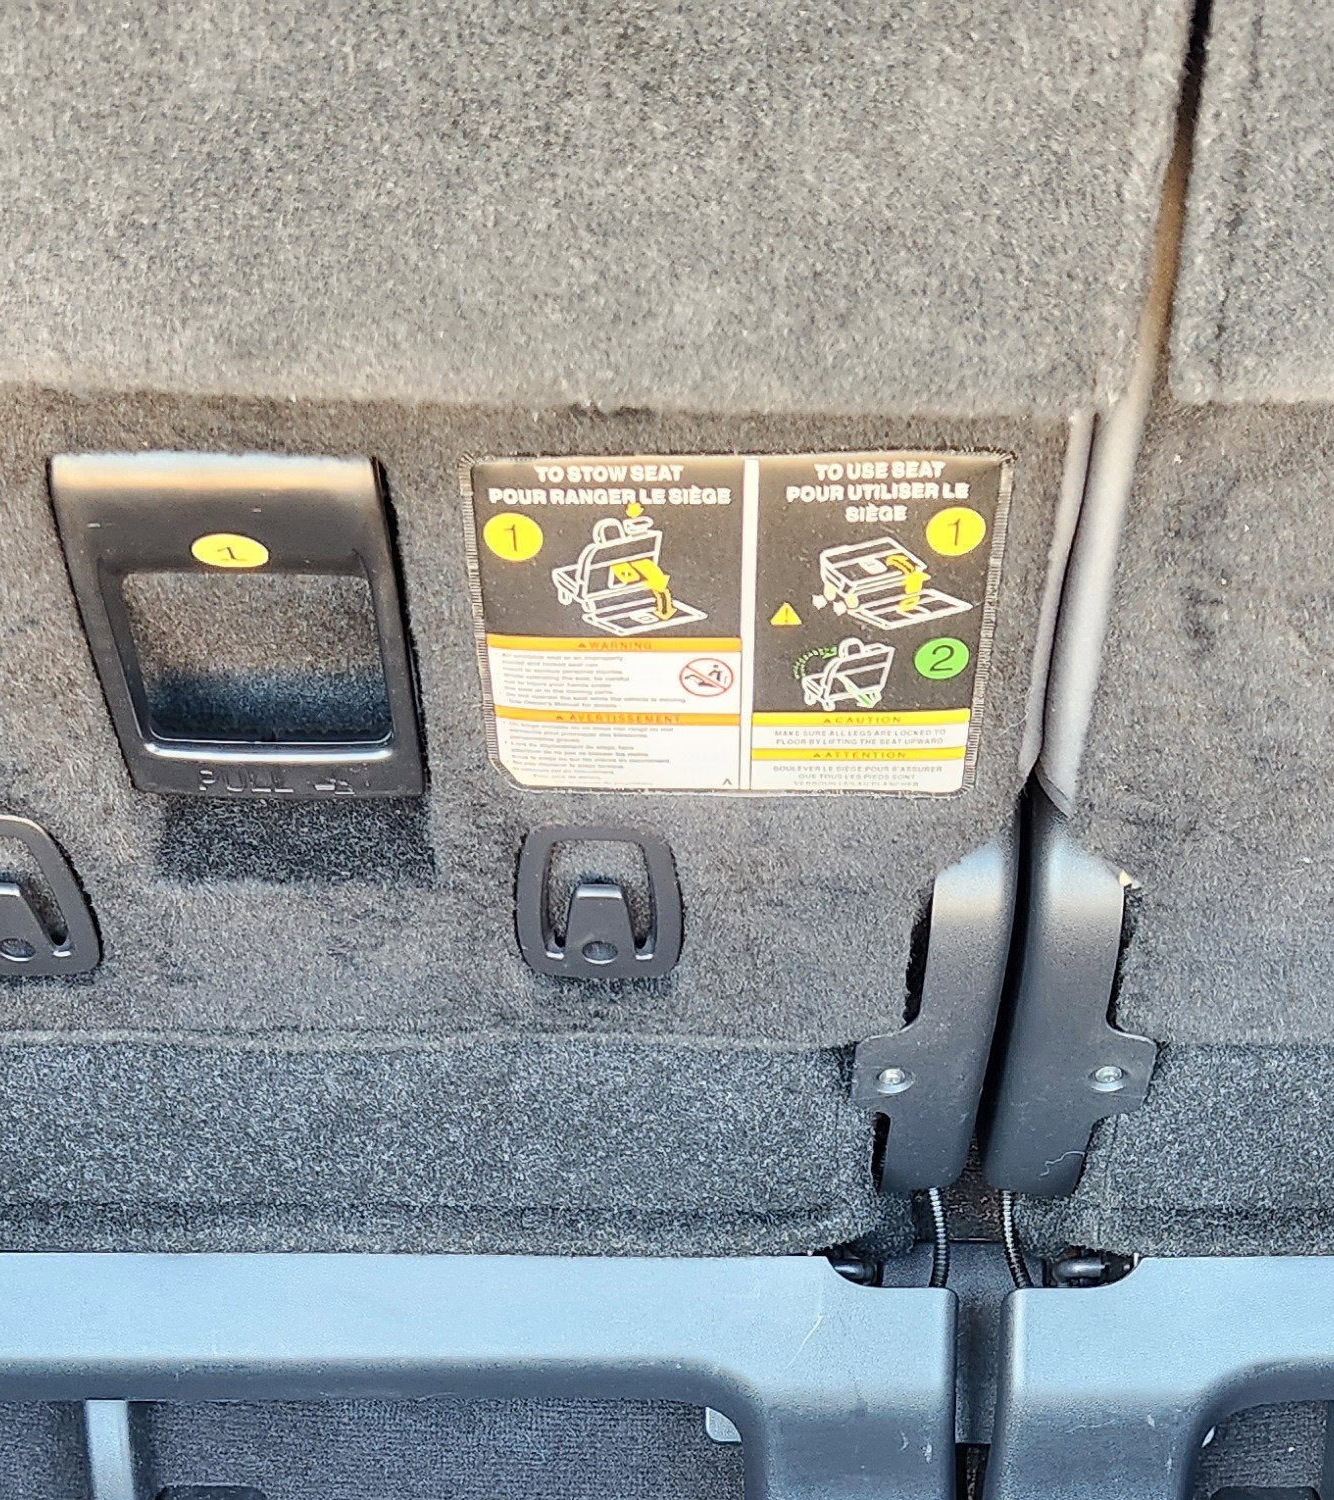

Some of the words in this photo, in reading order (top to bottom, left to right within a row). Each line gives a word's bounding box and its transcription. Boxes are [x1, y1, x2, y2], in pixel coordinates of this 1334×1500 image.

[534, 466, 564, 483] TO
[567, 465, 627, 483] STOW
[630, 465, 684, 482] SEAT
[814, 463, 844, 481] TO
[846, 462, 889, 480] USE
[892, 460, 946, 480] SEAT
[488, 487, 547, 505] POUR
[549, 487, 637, 505] RANGER
[639, 487, 666, 505] LE
[668, 485, 732, 505] SIÈGE
[786, 485, 844, 503] POUR
[847, 482, 940, 501] UTILISER
[942, 482, 970, 500] LE
[845, 502, 908, 523] SIÈGE
[503, 523, 518, 552] 1
[946, 518, 961, 547] 1
[588, 641, 653, 651] WARNING
[929, 644, 956, 672] 2
[835, 716, 901, 724] CAUTION
[825, 751, 906, 759] ATTENTION
